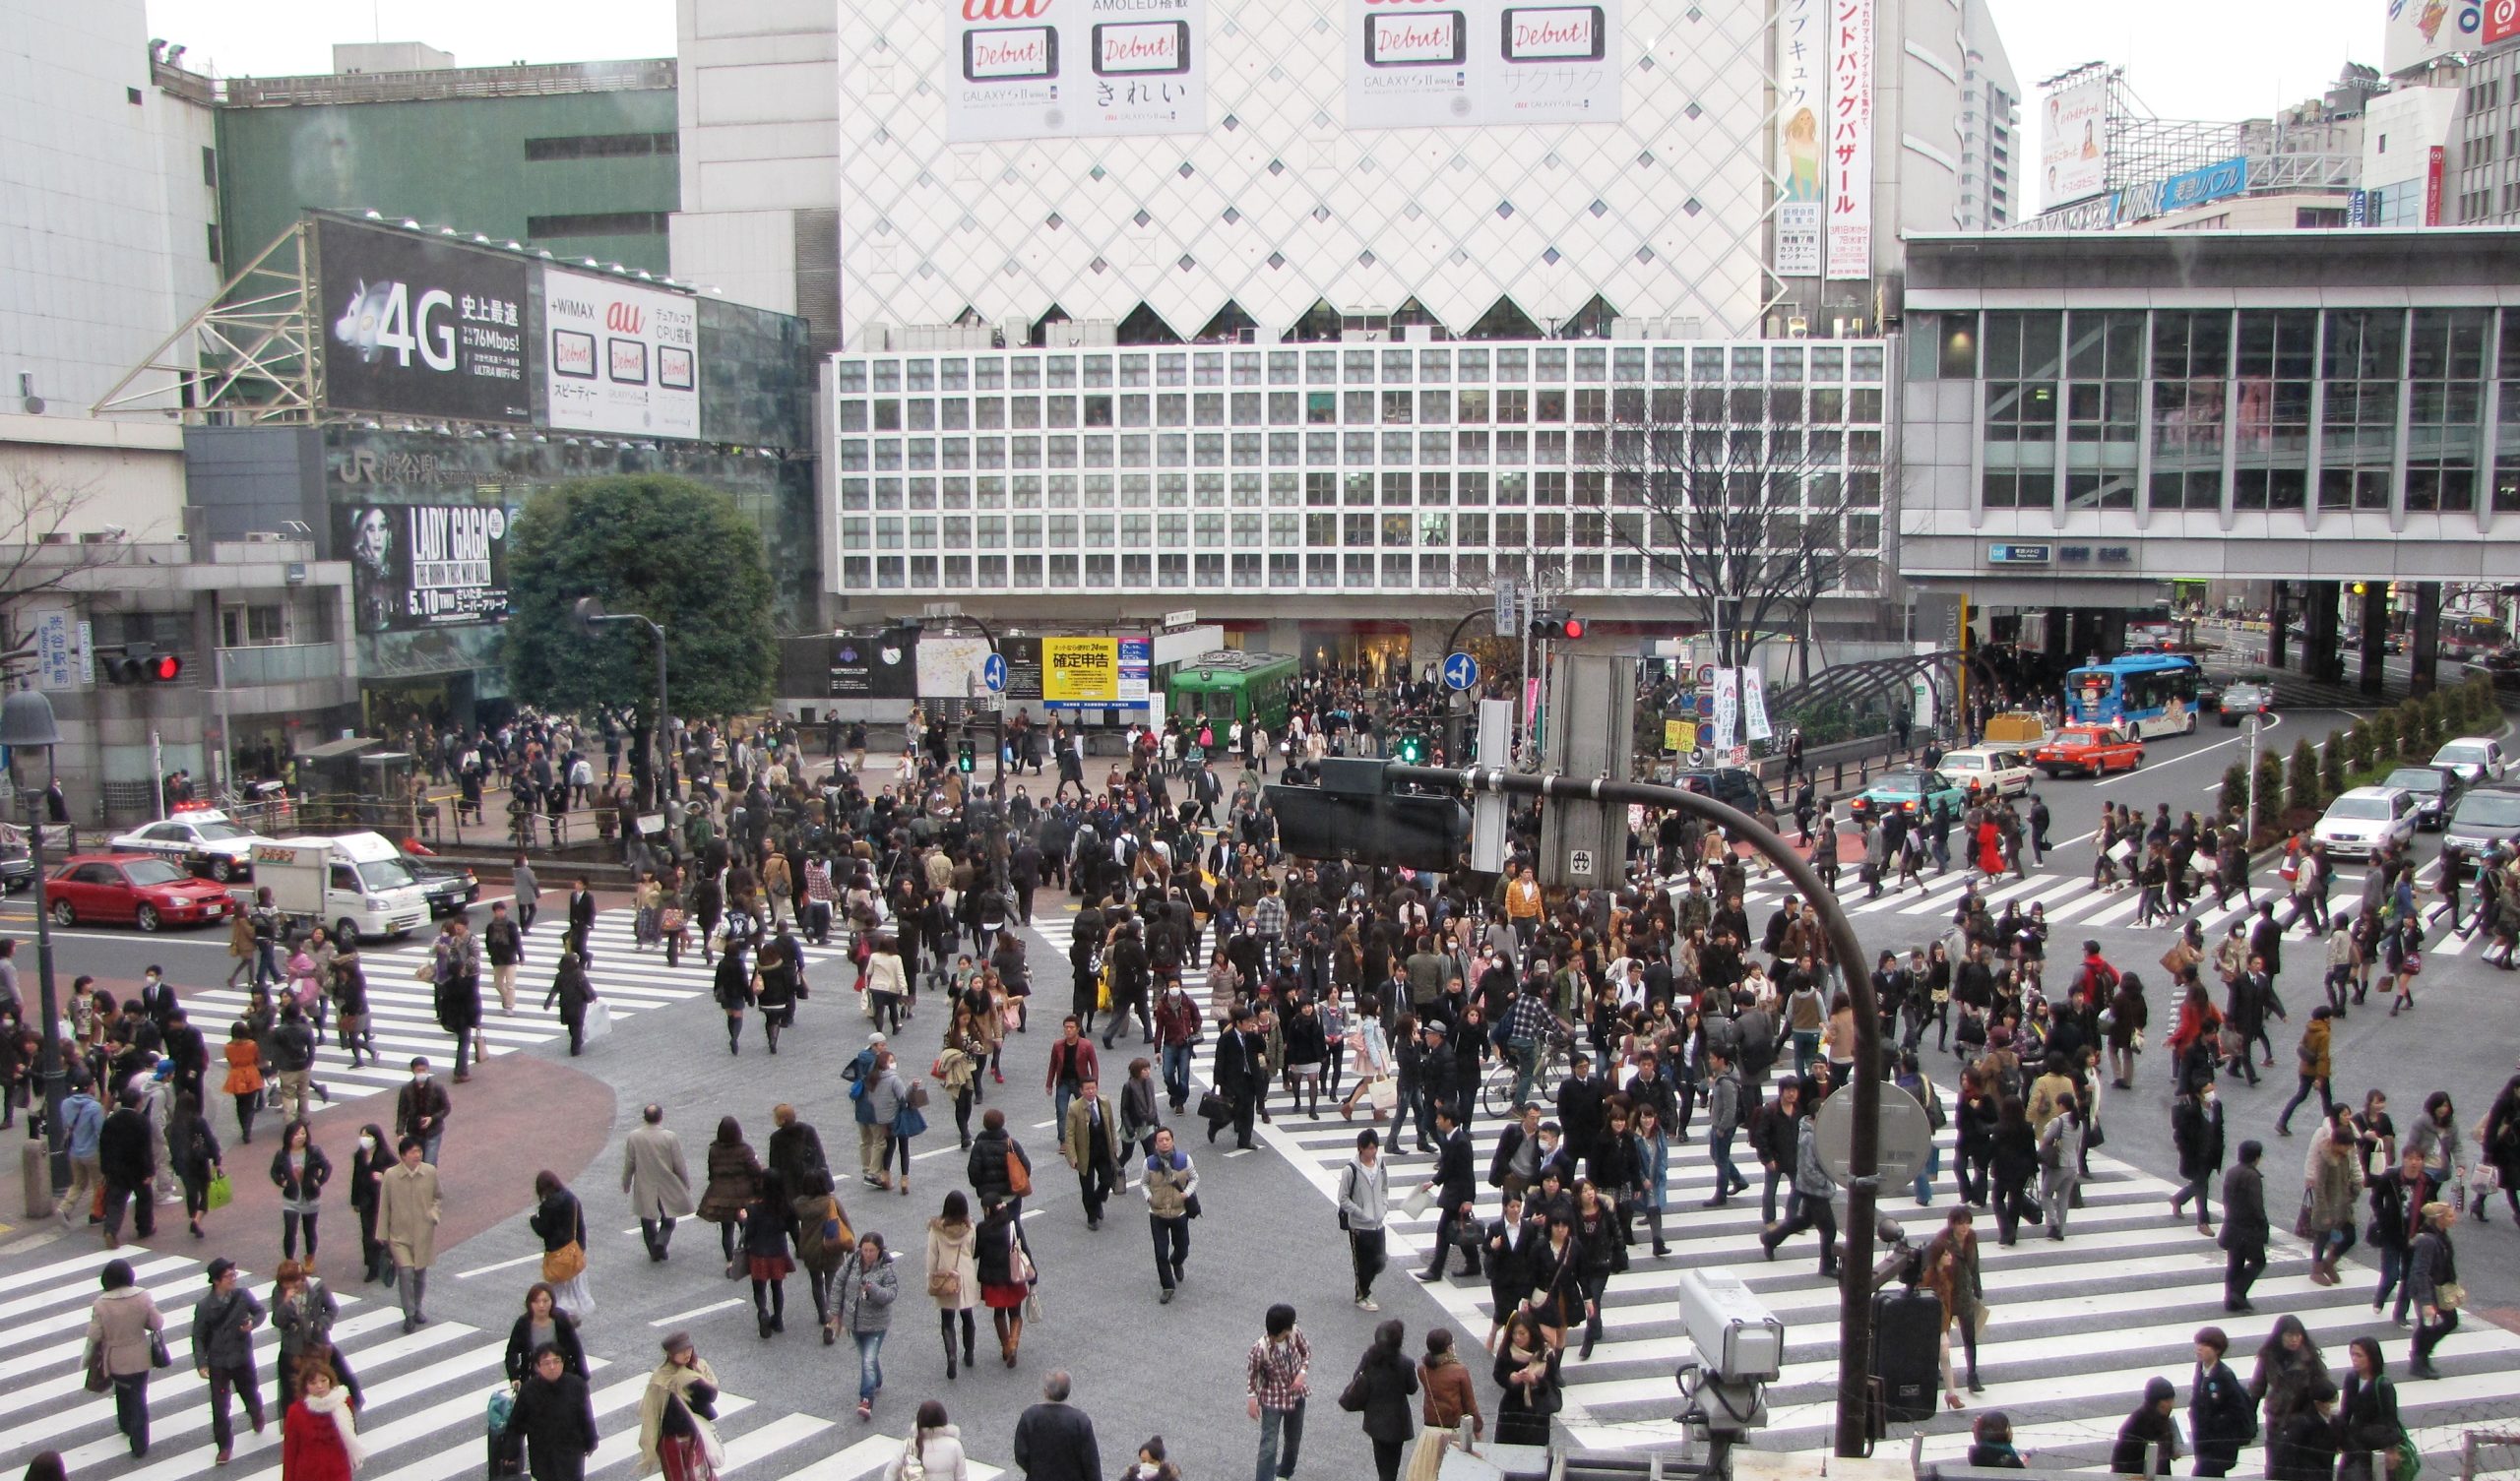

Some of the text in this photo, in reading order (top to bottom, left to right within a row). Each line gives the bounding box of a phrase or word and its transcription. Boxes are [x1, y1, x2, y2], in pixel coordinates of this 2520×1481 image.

[1378, 24, 1450, 53] Debut!
[1515, 20, 1590, 48] Debut!
[976, 39, 1043, 68] Debut!
[1104, 34, 1174, 63] Debut!
[1364, 76, 1409, 88] GALAXY
[1500, 67, 1604, 94] サクサク
[963, 90, 1006, 102] GALAXY
[1097, 81, 1186, 107] きれい
[461, 294, 520, 328] 史上最速
[551, 298, 596, 320] +WiMAX
[606, 301, 646, 335] au
[376, 281, 457, 372] 4G
[473, 328, 520, 352] 76Mbps!
[559, 343, 592, 365] Debut!
[613, 351, 644, 371] Debut!
[473, 365, 495, 377] ULTRA
[662, 358, 690, 377] Debut!
[340, 450, 377, 484] JR
[382, 452, 442, 484] 渋谷駅
[410, 507, 490, 561] LADY GAGA
[415, 561, 490, 586] THE BORN THIS WAY BALL
[410, 590, 455, 616] 5.10 THU
[456, 588, 482, 599] さいたま
[456, 598, 509, 612] スーパーアリーナ
[1502, 584, 1513, 632] 渋谷駅前
[1944, 604, 1960, 667] Smokig
[49, 616, 69, 684] 渋谷駅前
[1053, 653, 1108, 668] 確定申告
